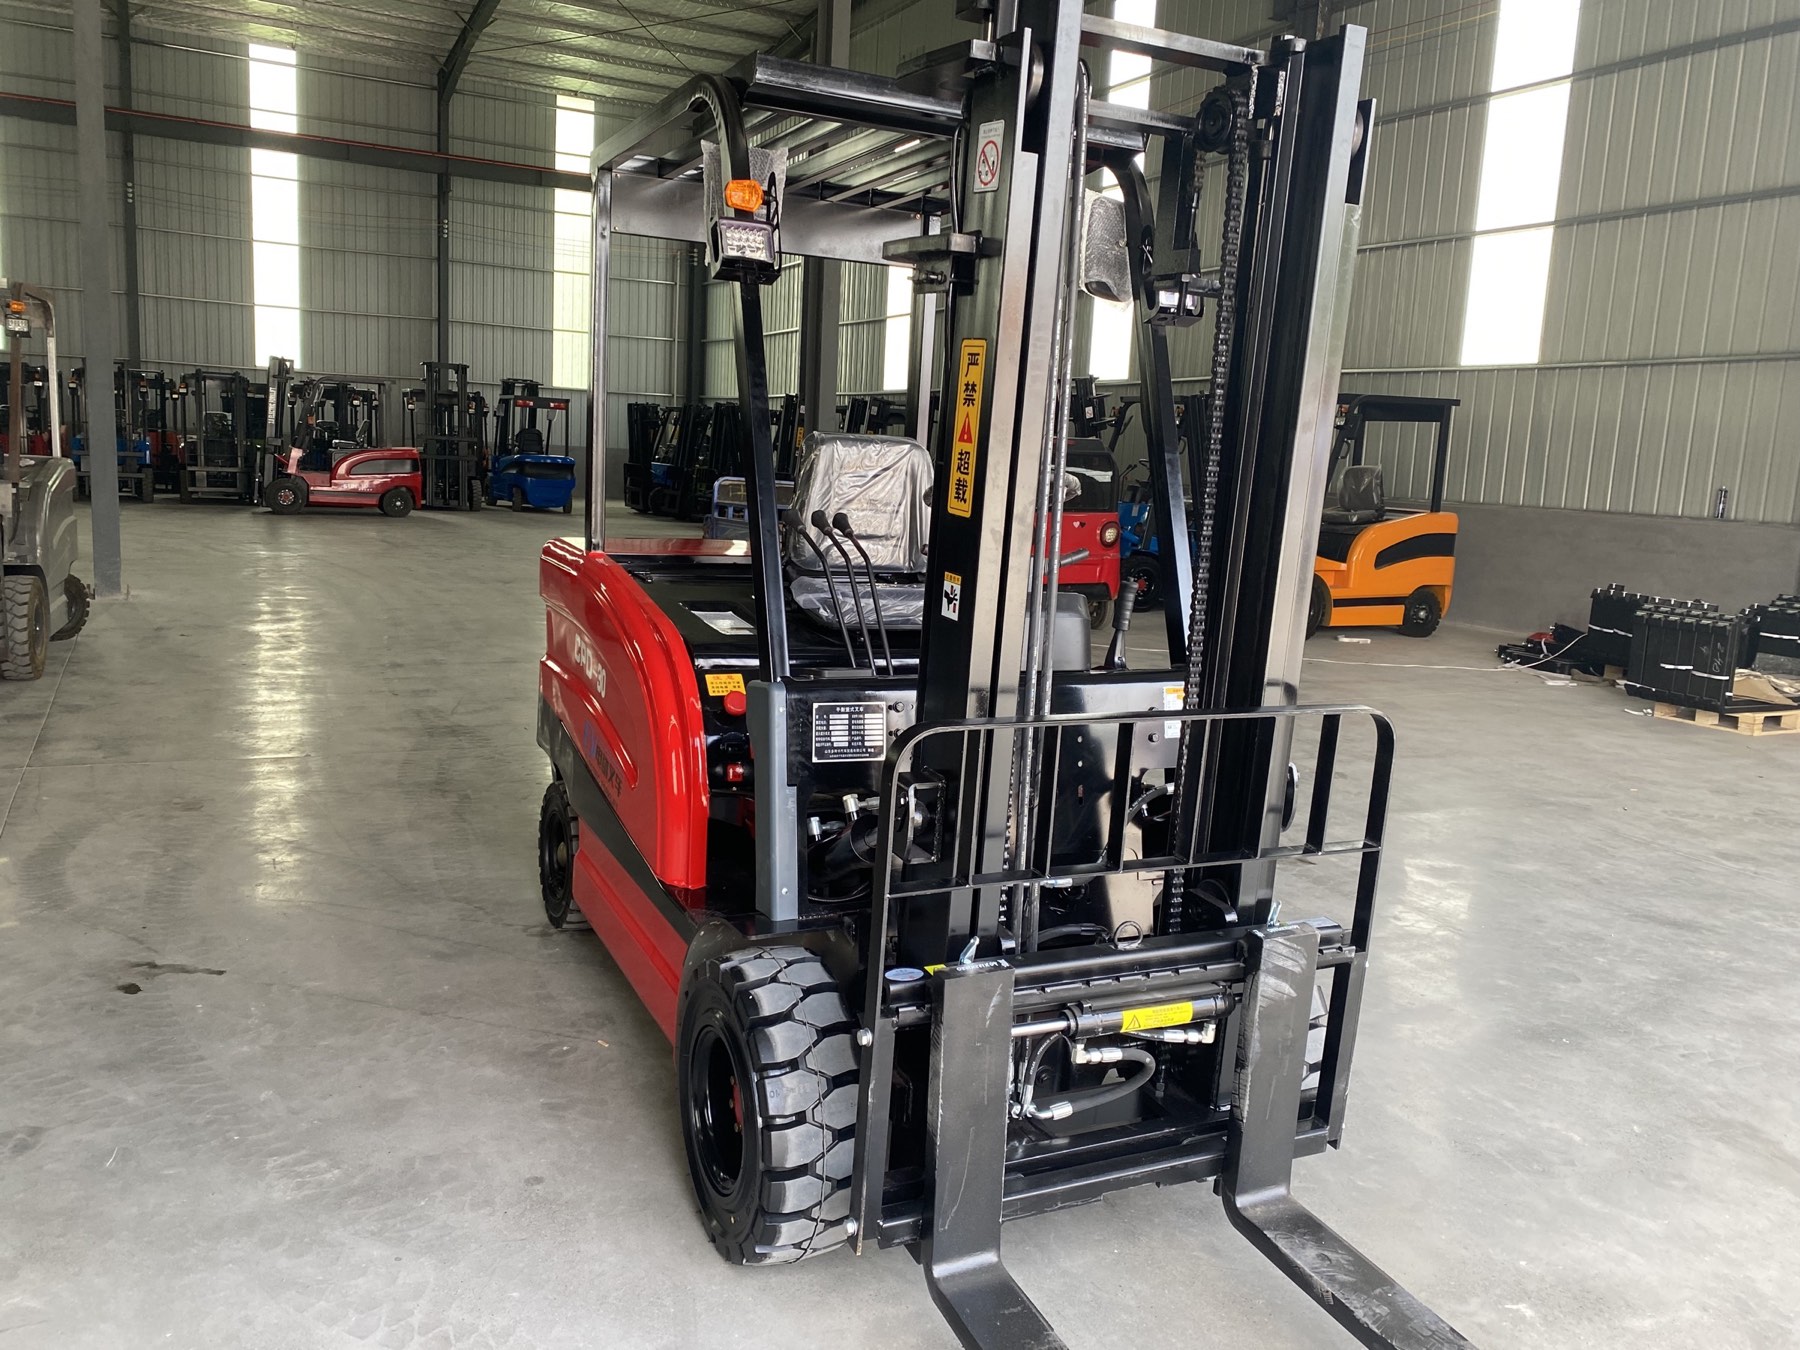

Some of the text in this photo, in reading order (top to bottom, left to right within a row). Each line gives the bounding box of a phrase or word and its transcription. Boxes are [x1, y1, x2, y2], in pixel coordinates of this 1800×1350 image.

[954, 353, 981, 504] 严禁 超载
[574, 633, 607, 699] CPD-30
